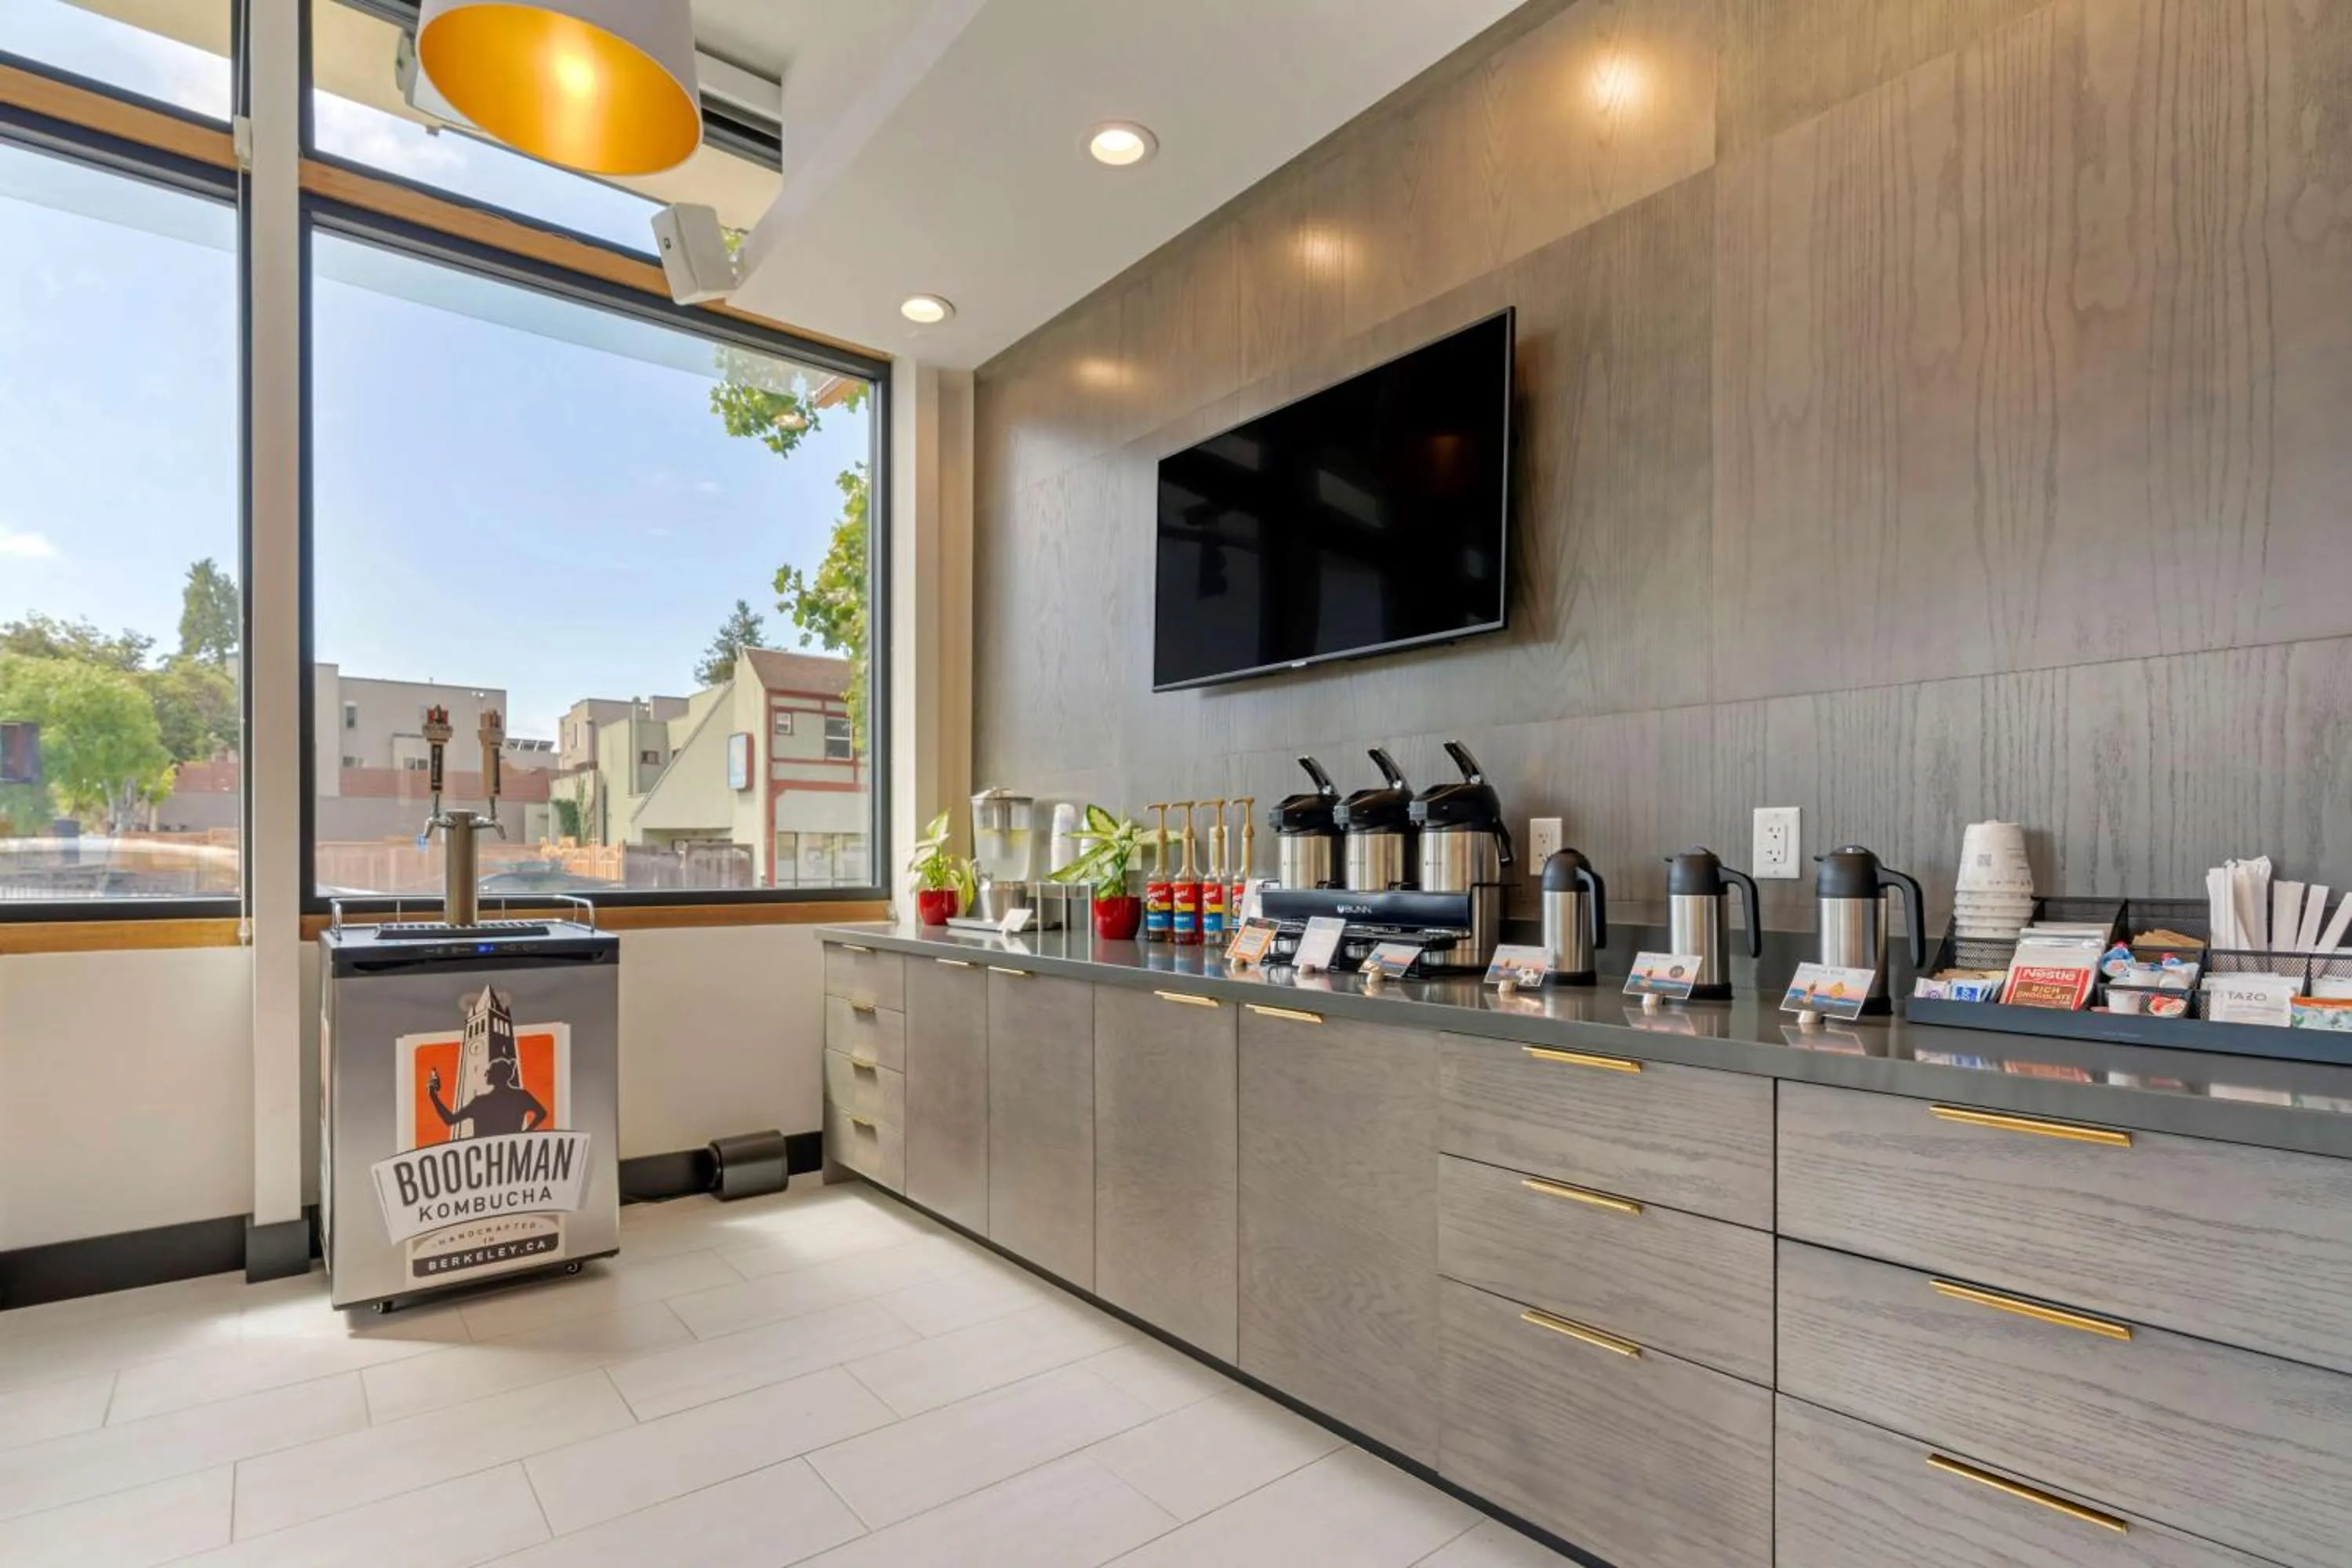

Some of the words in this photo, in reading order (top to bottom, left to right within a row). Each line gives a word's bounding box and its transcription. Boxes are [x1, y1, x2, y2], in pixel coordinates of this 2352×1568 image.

[2228, 991, 2267, 1001] TAZO
[394, 1138, 575, 1207] BOOCHMAN
[419, 1186, 552, 1222] KOMBUCHA
